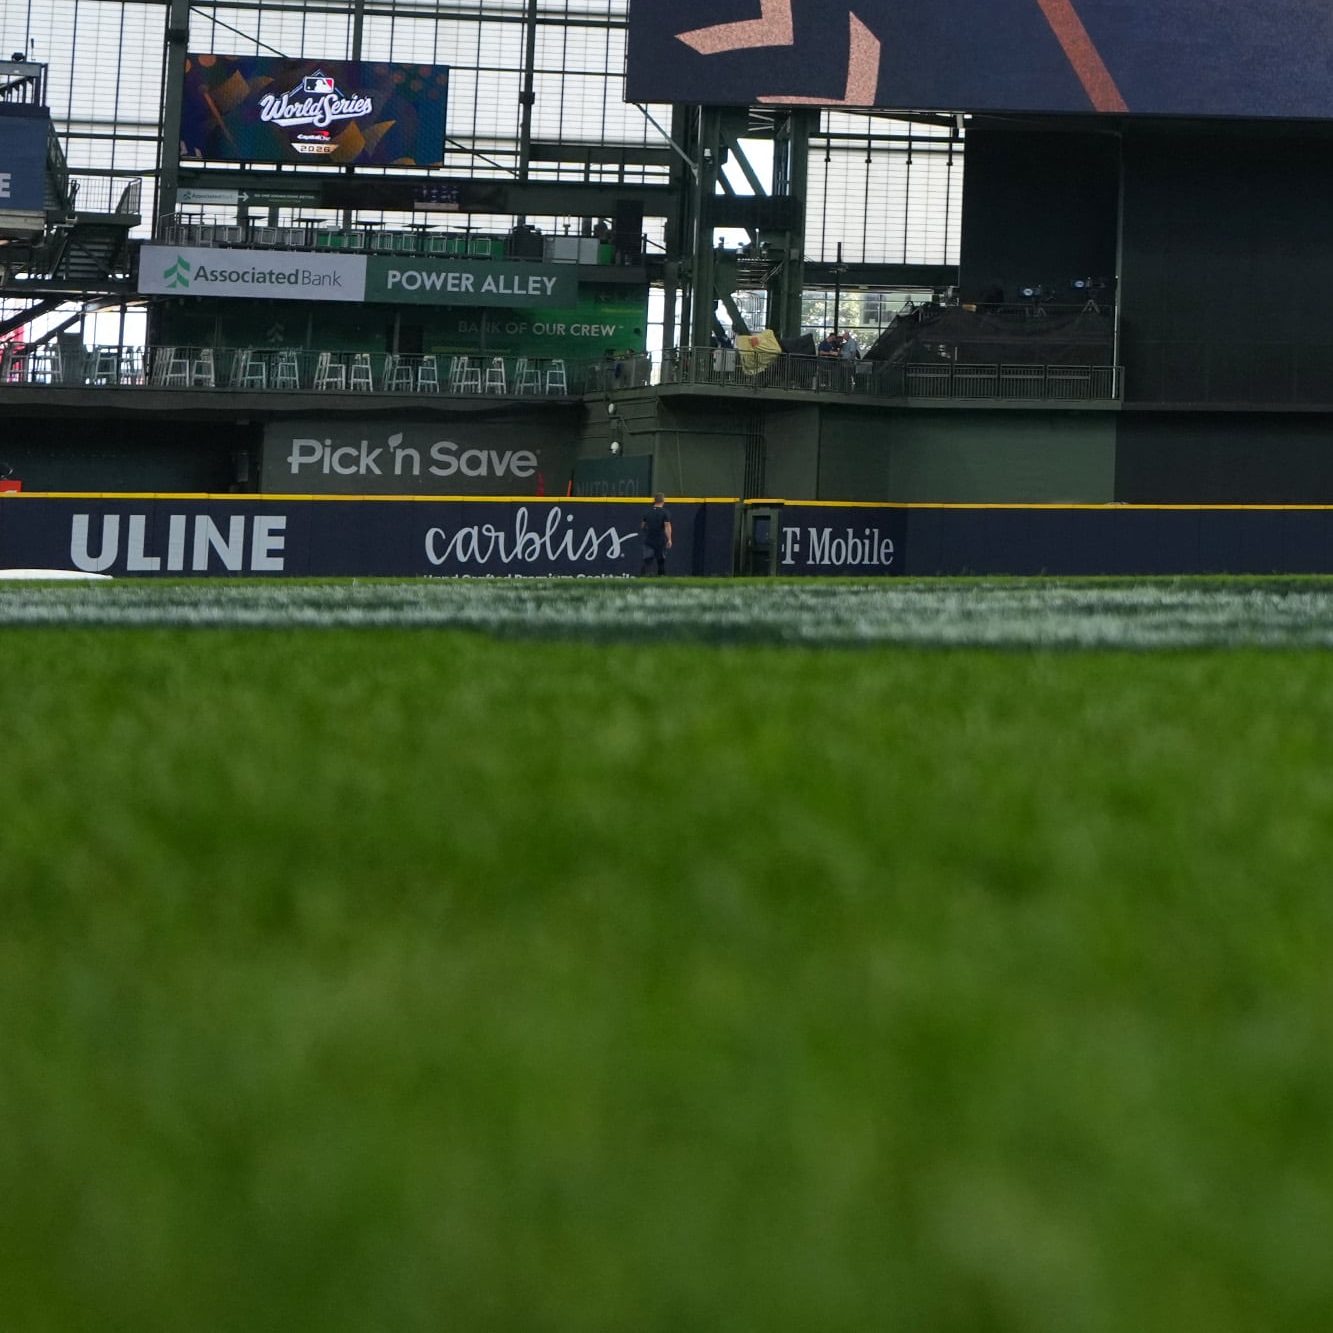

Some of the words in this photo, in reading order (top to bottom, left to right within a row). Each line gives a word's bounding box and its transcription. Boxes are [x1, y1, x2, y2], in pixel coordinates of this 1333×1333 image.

[300, 145, 331, 153] 2026
[387, 270, 474, 292] POWER
[480, 274, 558, 296] ALLEY
[458, 320, 501, 334] BANK
[506, 322, 529, 335] OF
[532, 323, 565, 336] OUR
[570, 324, 617, 337] CREW
[287, 438, 383, 475] Pick
[428, 441, 539, 478] Save
[70, 514, 287, 572] ULINE
[424, 506, 639, 565] carbliss
[806, 527, 894, 566] Mobile
